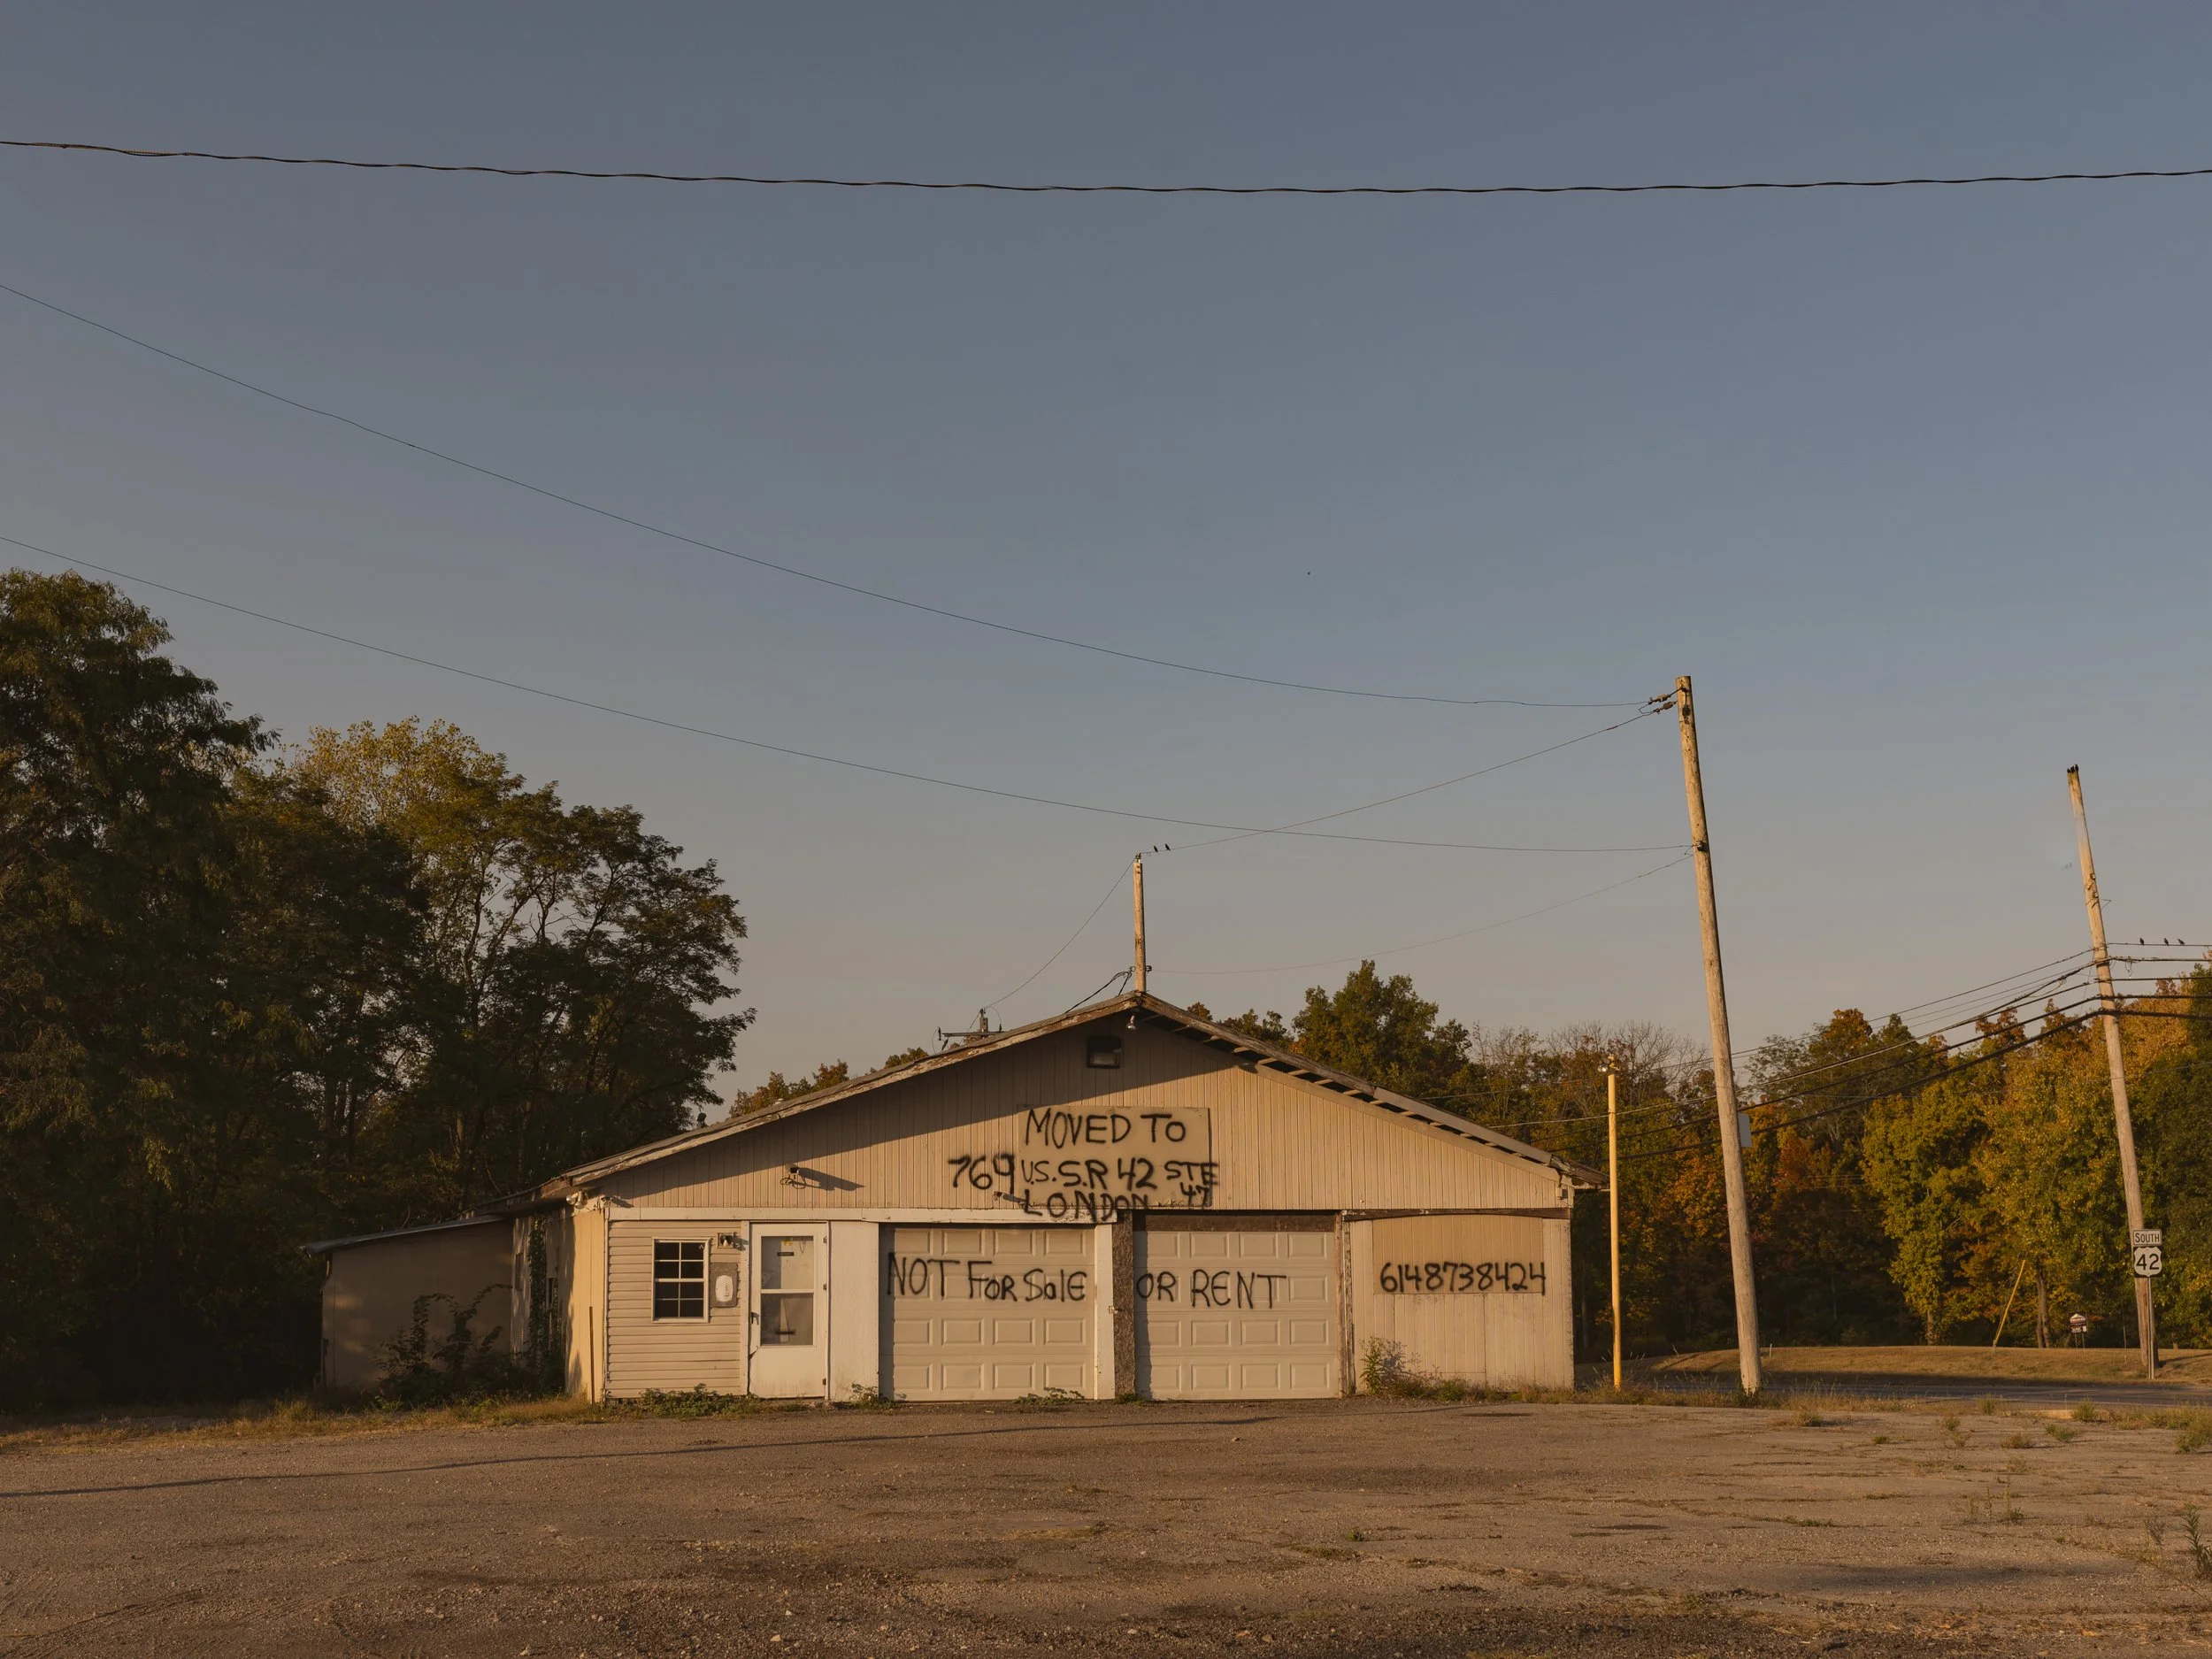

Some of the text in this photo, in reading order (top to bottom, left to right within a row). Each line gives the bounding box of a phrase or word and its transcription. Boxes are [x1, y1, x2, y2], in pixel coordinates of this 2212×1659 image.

[1025, 1108, 1187, 1149] MOVED TO
[948, 1153, 1015, 1195] 769
[1117, 1157, 1157, 1191] 42
[1164, 1160, 1219, 1186] STE
[1023, 1189, 1148, 1222] LONDON
[2135, 1233, 2160, 1243] SOUTH
[887, 1252, 960, 1298] NOT
[1380, 1261, 1546, 1296] 6148738424
[2136, 1253, 2160, 1271] 42
[1136, 1269, 1287, 1310] OR RENT
